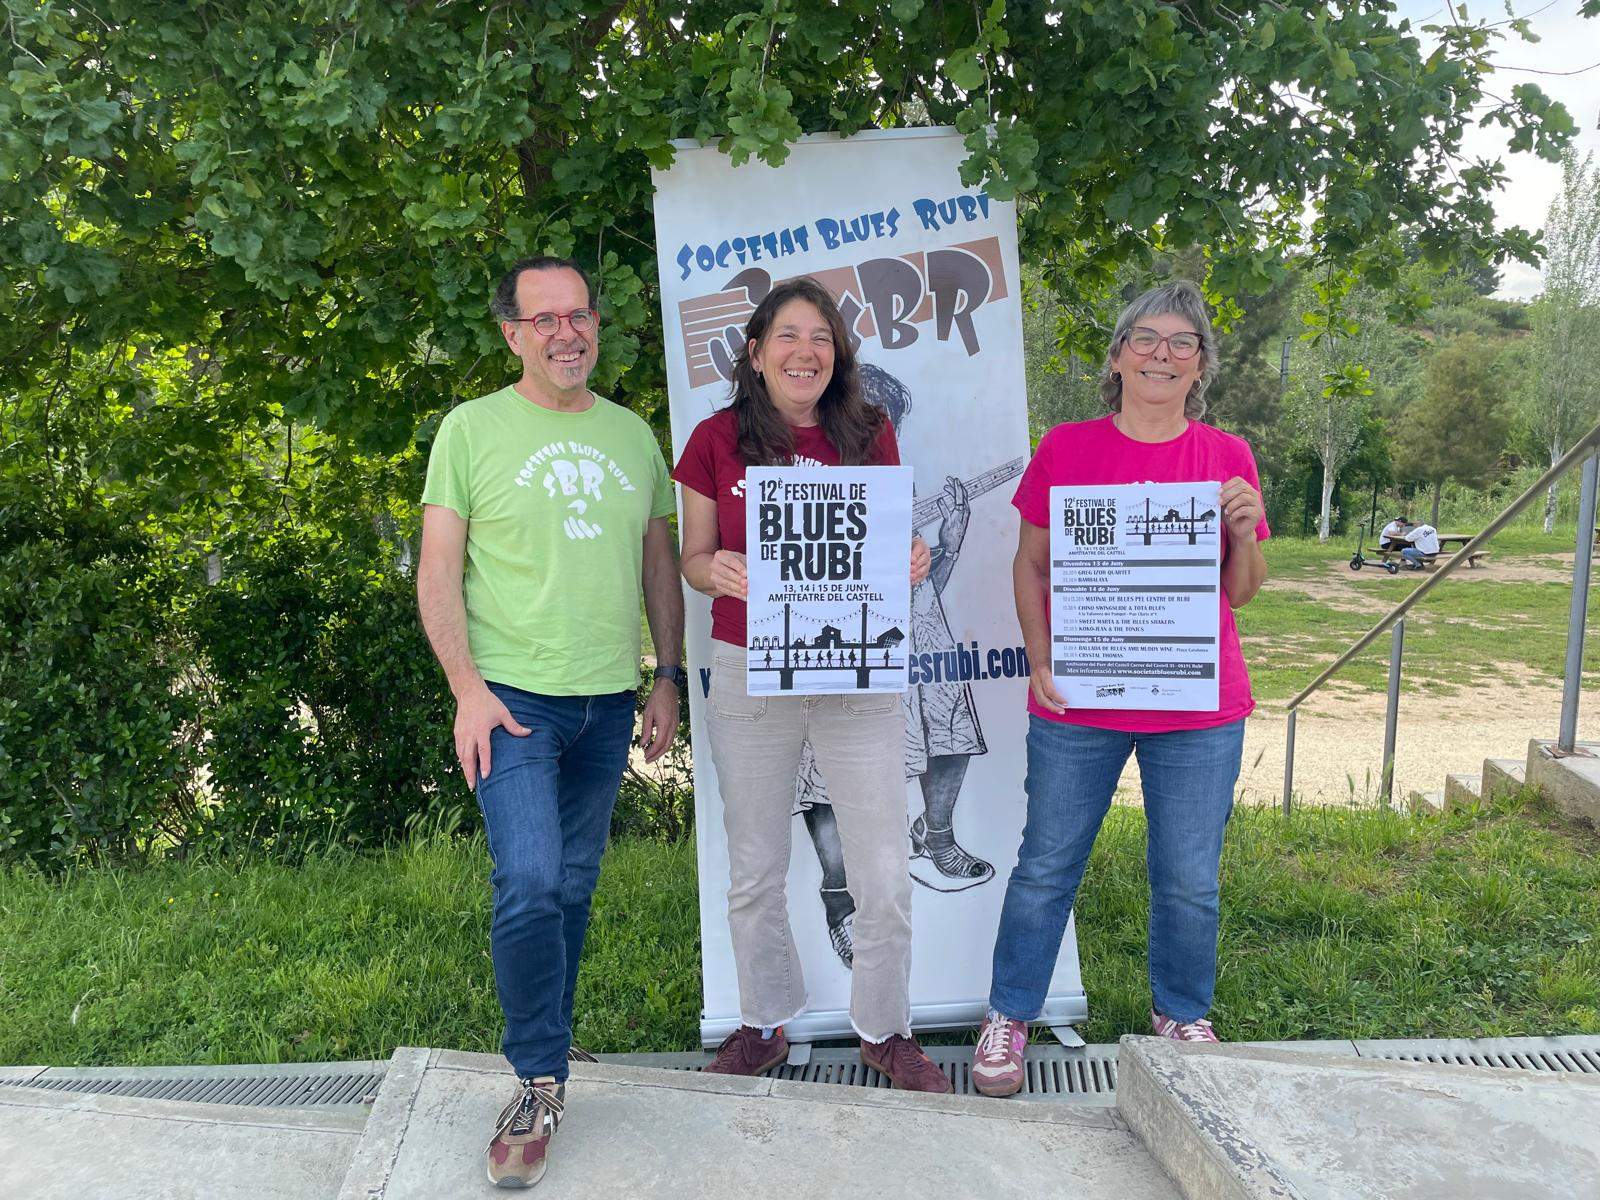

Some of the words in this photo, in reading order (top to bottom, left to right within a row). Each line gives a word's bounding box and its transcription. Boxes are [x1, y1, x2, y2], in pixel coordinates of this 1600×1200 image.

[815, 207, 901, 251] BLUES
[568, 441, 606, 462] BLUES
[784, 483, 846, 501] FESTIVAL
[850, 483, 867, 500] DE
[1076, 498, 1106, 507] FESTIVAL
[1107, 498, 1116, 507] DE
[759, 502, 867, 542] BLUES
[1064, 507, 1117, 527] BLUES
[1065, 528, 1074, 536] DE
[761, 544, 778, 561] DE
[784, 584, 796, 593] 13,
[800, 584, 810, 593] 14
[818, 584, 828, 593] 15
[831, 584, 844, 593] DE
[845, 584, 869, 593] JUNY
[768, 593, 825, 602] AMFITEATRE
[828, 593, 844, 602] DEL
[846, 593, 884, 602] CASTELL
